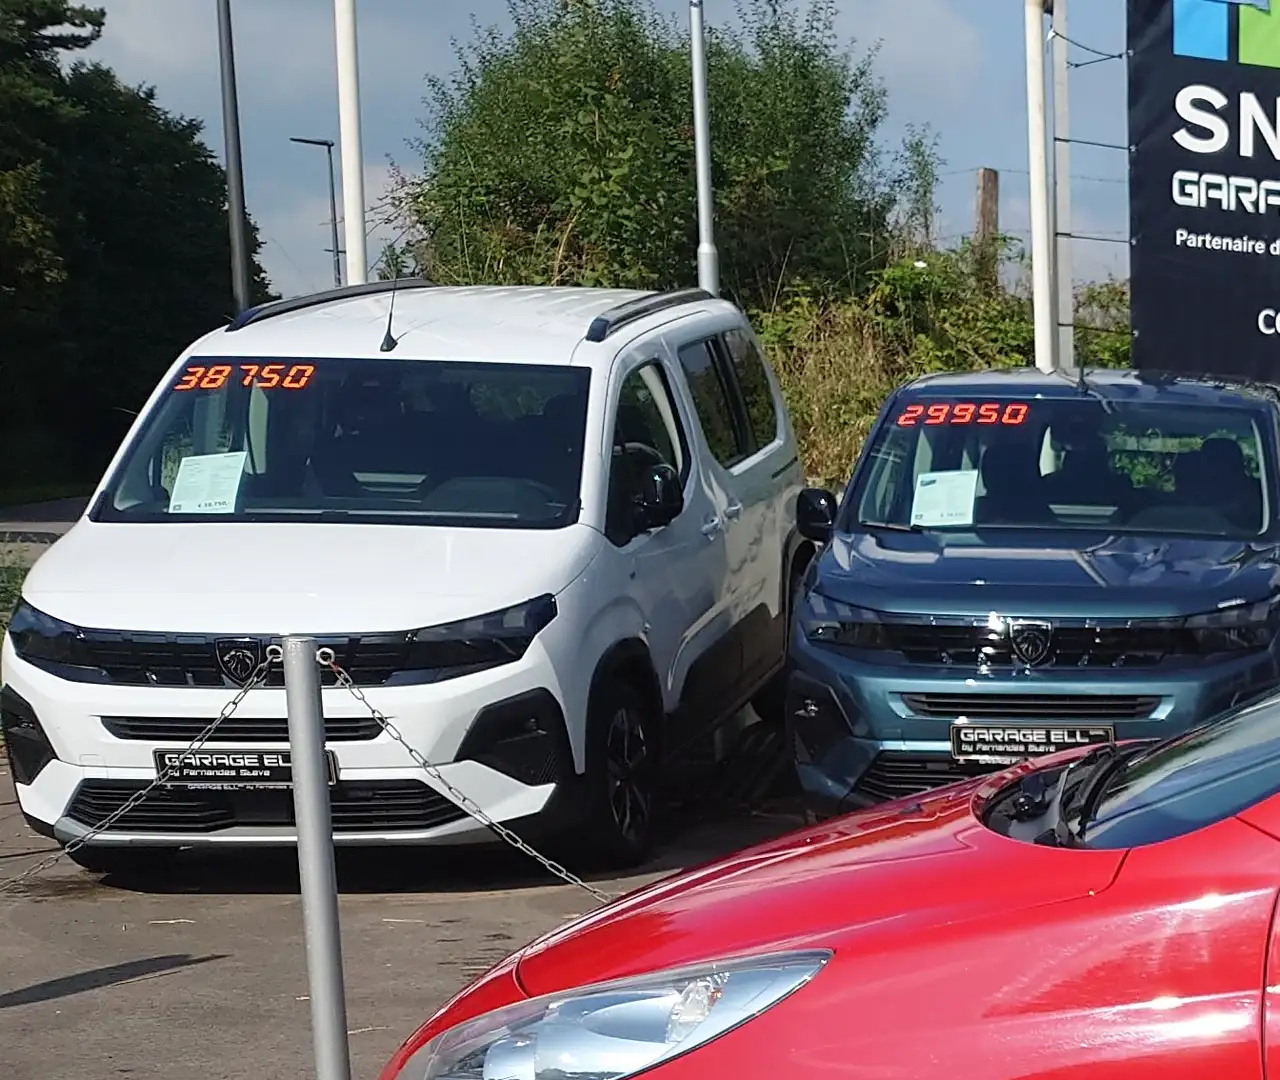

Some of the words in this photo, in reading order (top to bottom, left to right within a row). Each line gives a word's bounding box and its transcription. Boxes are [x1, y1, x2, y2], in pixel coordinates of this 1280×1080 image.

[1175, 229, 1265, 254] Partenaire
[174, 364, 233, 391] 38
[239, 363, 315, 391] 750
[896, 402, 1030, 426] 29950
[960, 729, 1046, 743] GARAGE
[1050, 730, 1090, 743] ELL
[961, 743, 974, 752] by
[165, 754, 259, 767] GARAGE
[263, 754, 292, 767] EL
